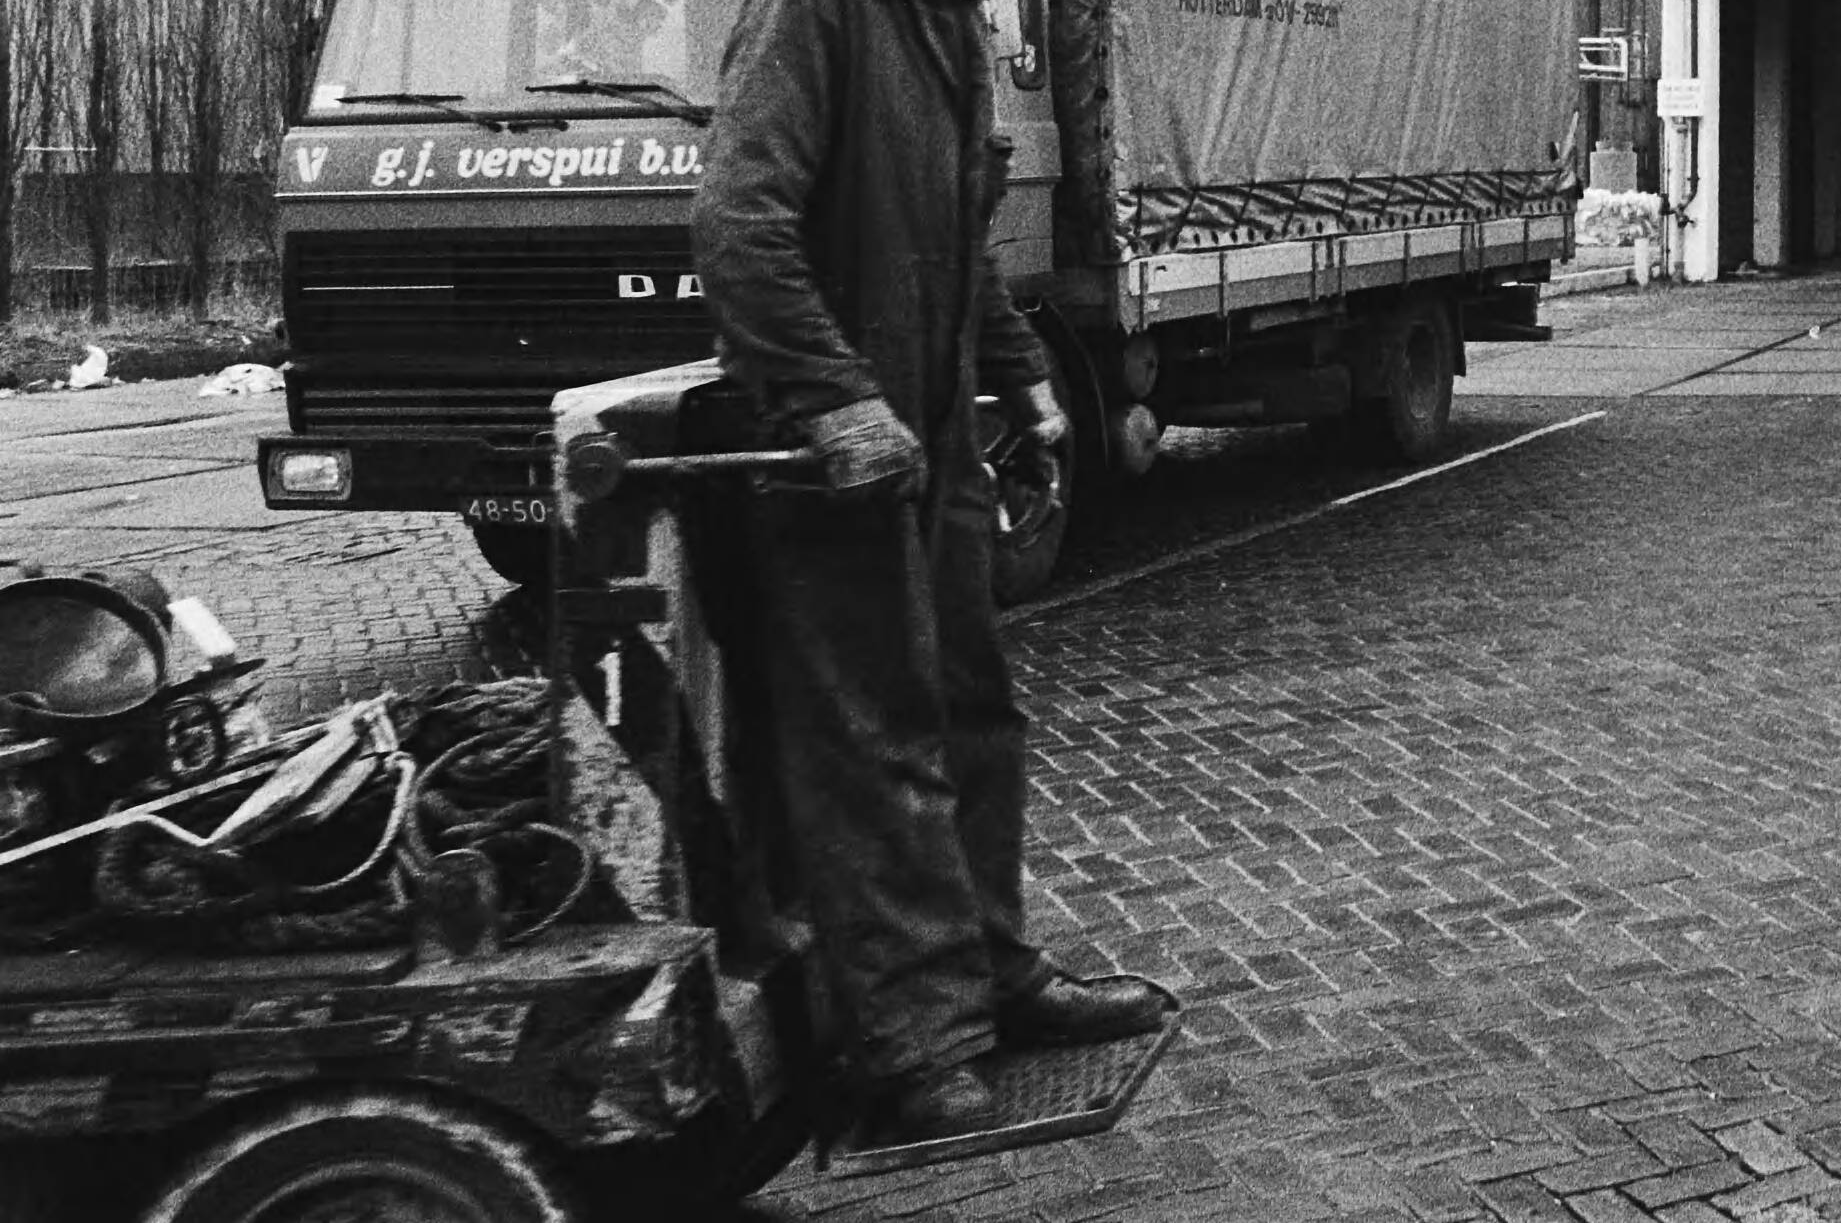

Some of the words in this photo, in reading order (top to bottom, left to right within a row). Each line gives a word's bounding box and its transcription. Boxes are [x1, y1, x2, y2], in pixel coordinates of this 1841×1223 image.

[372, 141, 435, 186] g.j.
[457, 138, 625, 186] verspui
[639, 138, 703, 176] b.v.
